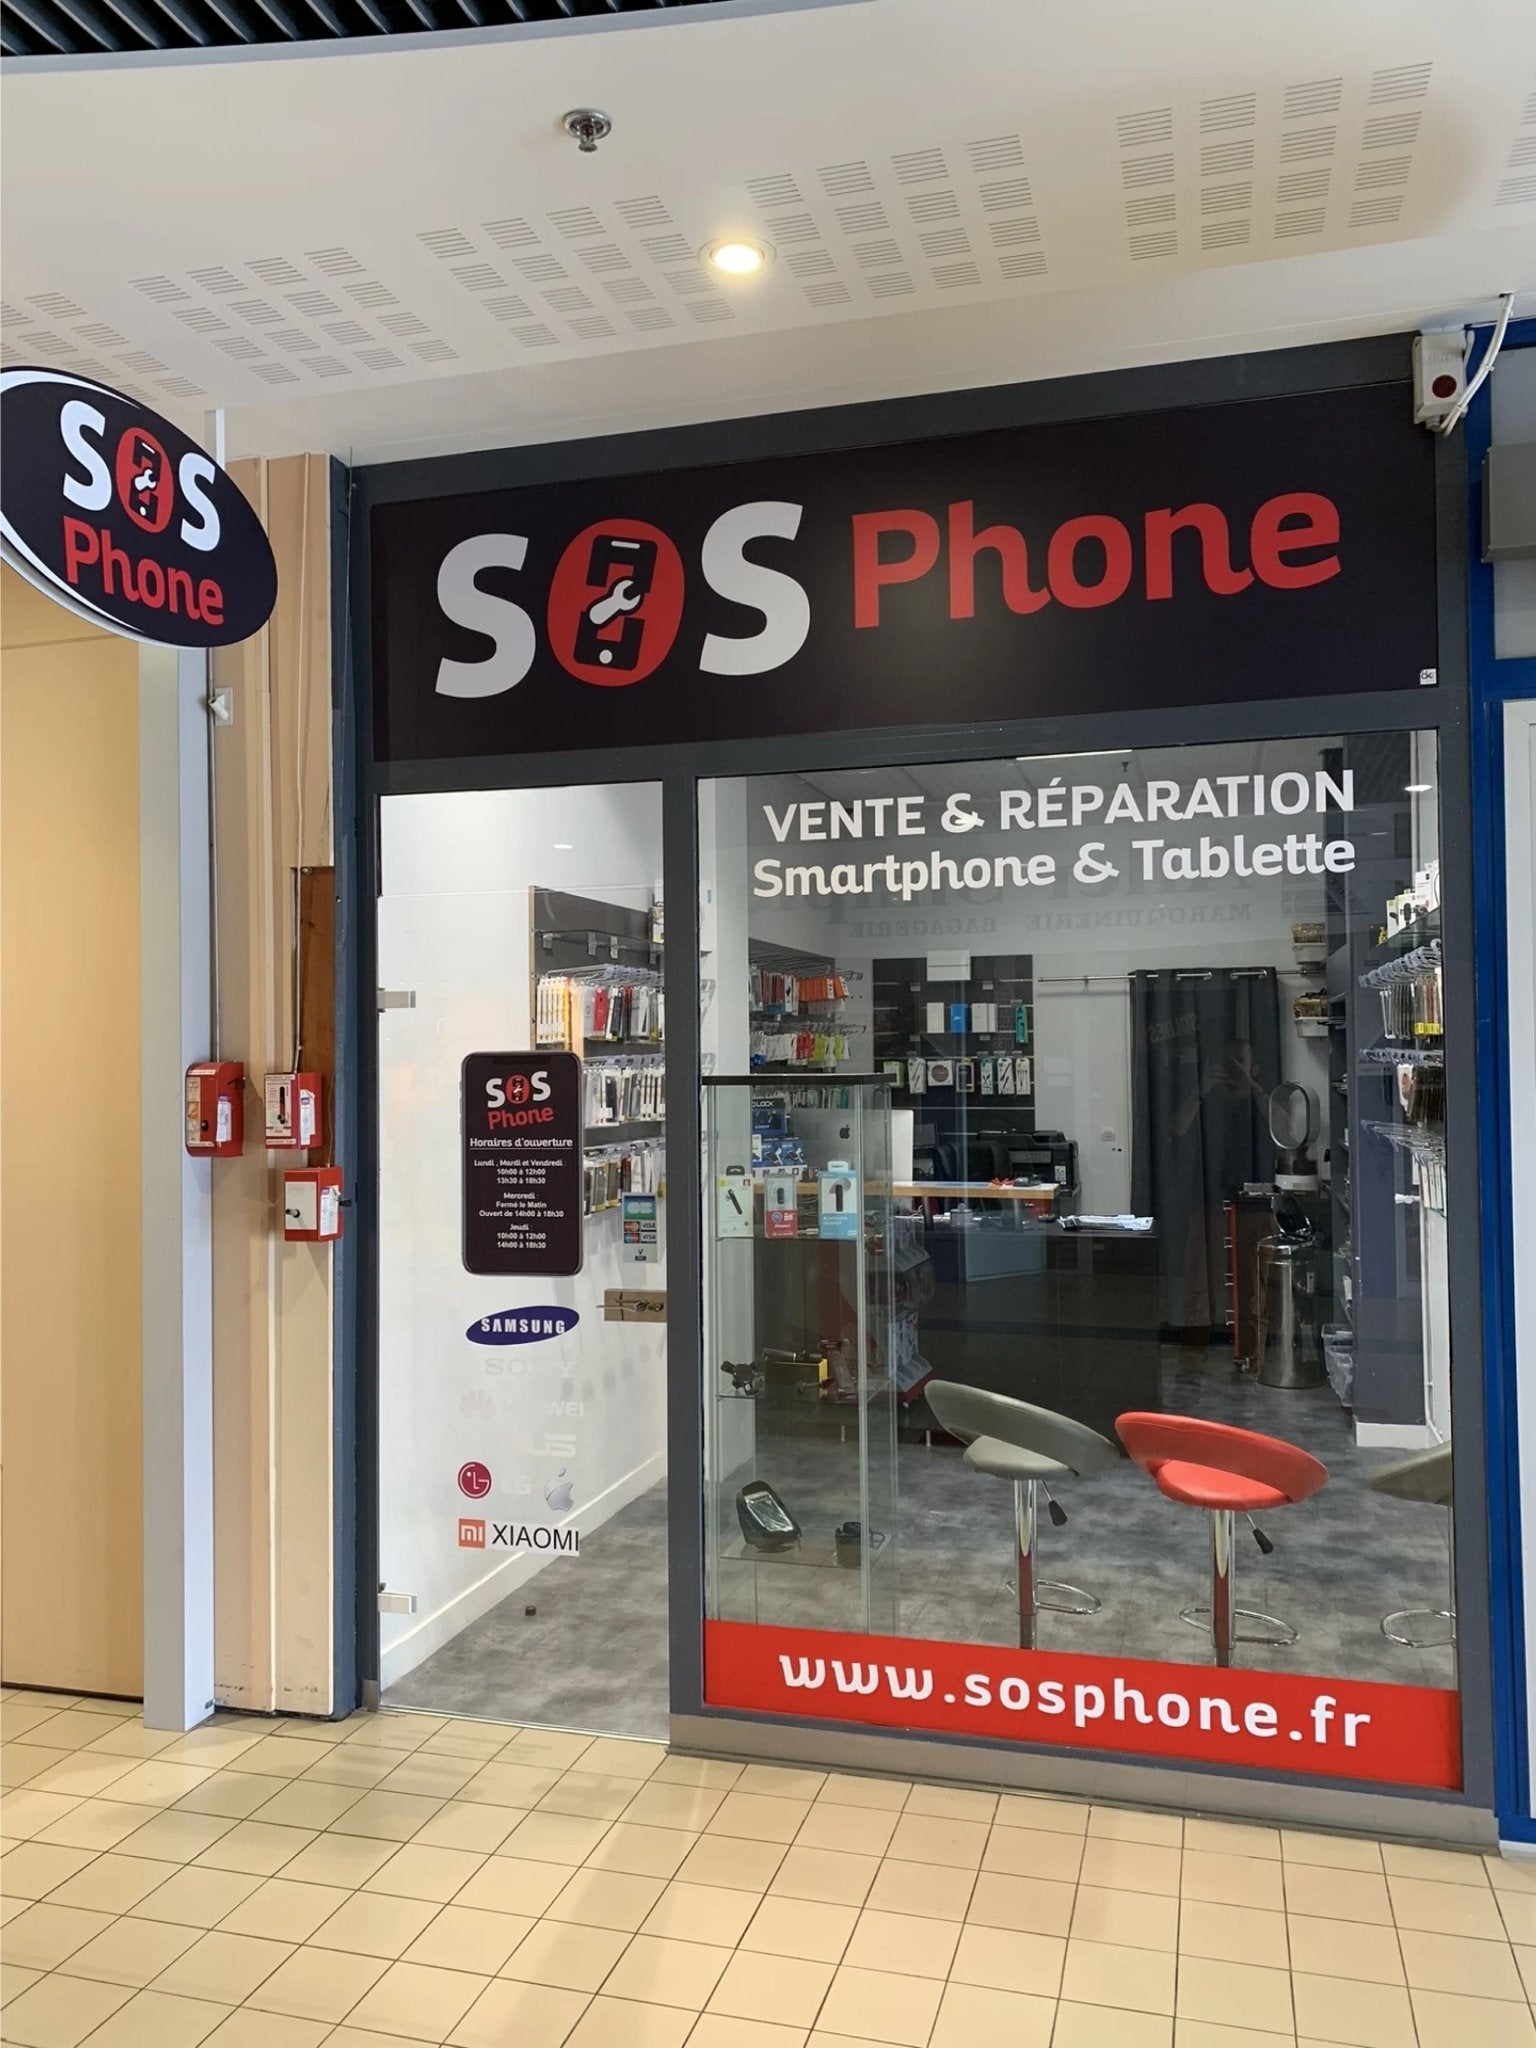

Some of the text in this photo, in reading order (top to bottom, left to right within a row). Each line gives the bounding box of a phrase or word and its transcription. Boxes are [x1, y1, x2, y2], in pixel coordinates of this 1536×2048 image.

[60, 400, 221, 551] SOS
[63, 515, 224, 626] Phone
[435, 492, 1341, 699] SOS Phone
[762, 769, 1354, 842] VENTE & RÉPARATION
[753, 850, 1056, 901] Smartphone
[1073, 842, 1120, 884] &
[1132, 833, 1356, 881] Tablette
[486, 1071, 551, 1108] SOS
[487, 1106, 554, 1130] Phone
[470, 1137, 573, 1148] Horaires d'ouverture
[474, 1159, 494, 1167] Lundi
[499, 1159, 521, 1167] Mardi
[530, 1159, 563, 1167] Vendredi
[496, 1168, 546, 1176] 10h00 à 12h00
[496, 1177, 546, 1185] 13h30 à 18h30
[503, 1192, 536, 1200] Mercredi
[519, 1201, 526, 1209] le
[527, 1201, 547, 1209] Matin
[478, 1210, 565, 1218] Ouvert de 14h00 à 18h30
[509, 1223, 530, 1231] Jeudi
[519, 1232, 524, 1240] à
[525, 1232, 546, 1240] 12h00
[497, 1241, 547, 1249] 14h00 à 18h30
[481, 1318, 566, 1335] SAMSUNG
[484, 1357, 578, 1379] SOY
[492, 1522, 580, 1552] XIAOMI
[779, 1653, 1371, 1747] www.sosphone.fr
